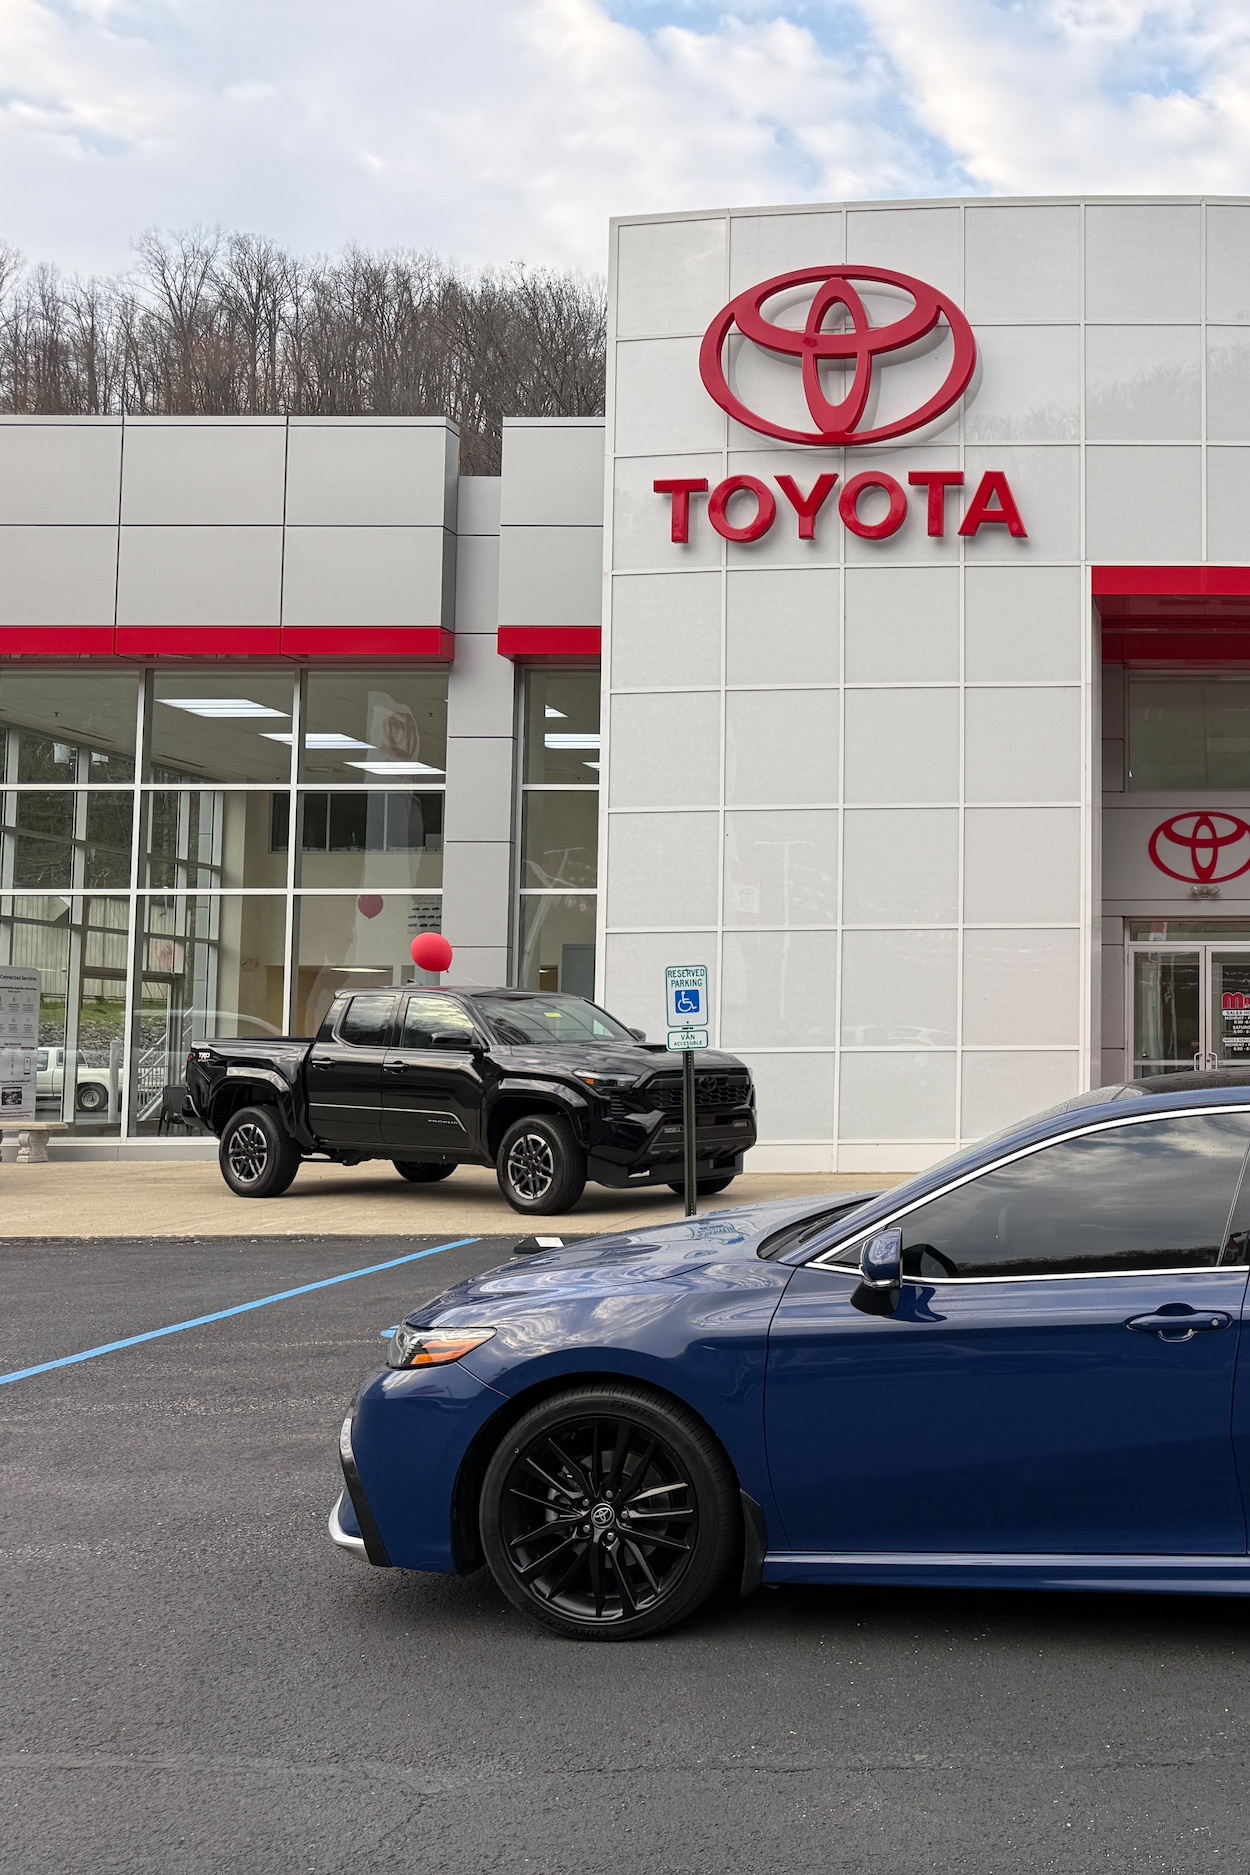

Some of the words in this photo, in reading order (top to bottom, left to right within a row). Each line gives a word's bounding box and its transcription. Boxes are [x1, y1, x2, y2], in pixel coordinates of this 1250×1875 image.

[653, 470, 1029, 544] TOYOTA
[667, 968, 705, 978] RESERVED
[671, 978, 703, 987] PARKING
